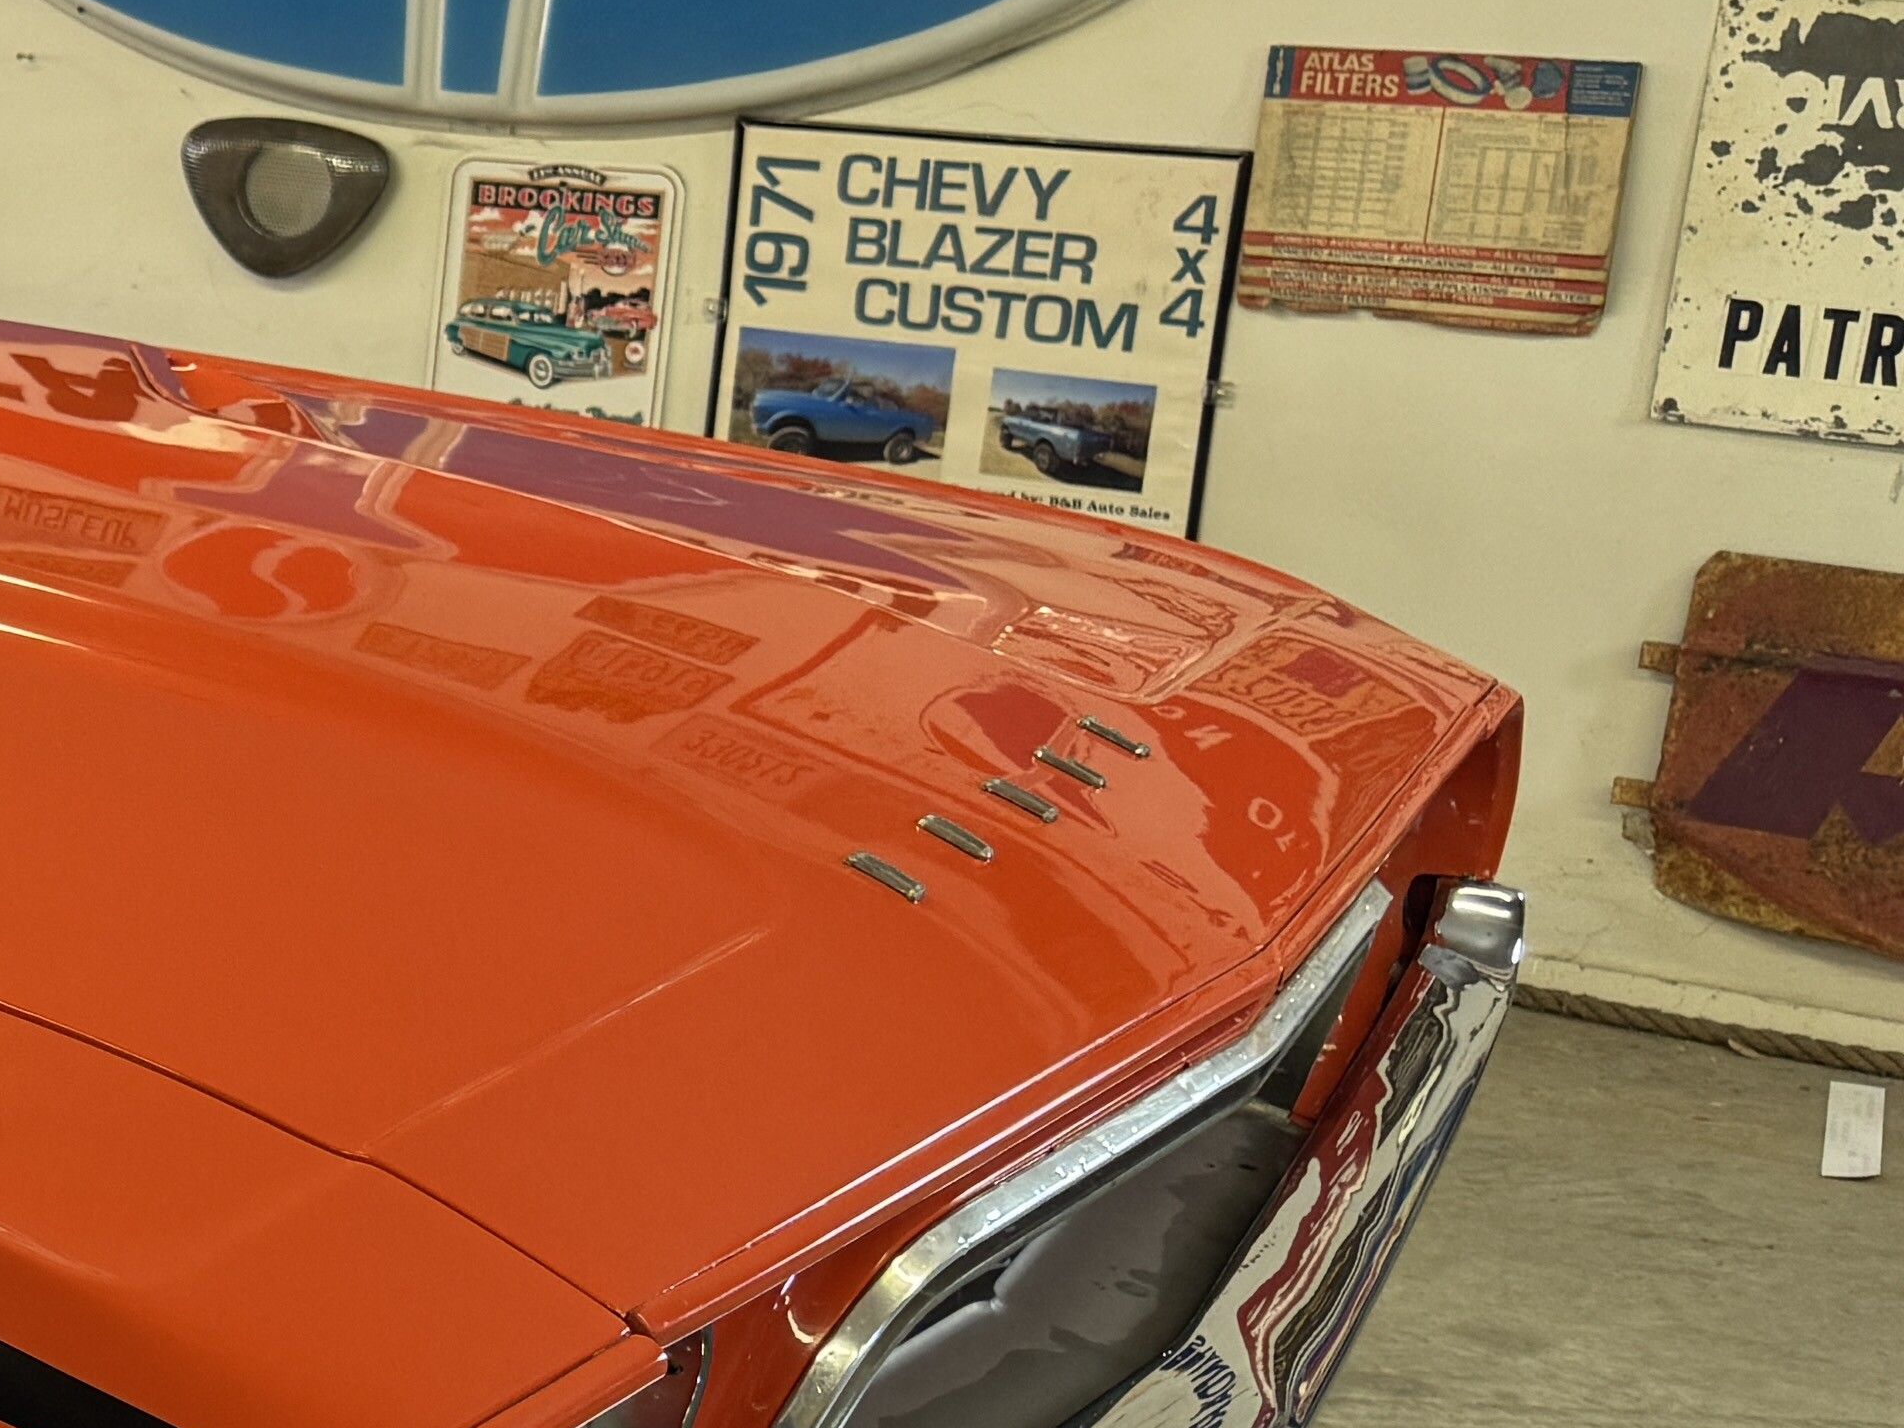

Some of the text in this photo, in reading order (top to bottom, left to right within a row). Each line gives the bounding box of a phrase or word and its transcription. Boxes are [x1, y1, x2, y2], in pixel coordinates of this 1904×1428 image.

[1299, 71, 1401, 98] FILTERS
[1303, 51, 1375, 72] ATLAS
[477, 184, 656, 217] BROOKINGS
[836, 152, 1070, 221] CHEVY
[536, 205, 590, 267] Car
[743, 152, 822, 308] 1971
[845, 217, 1098, 285] BLAZER
[854, 276, 1140, 354] CUSTOM
[1717, 297, 1904, 388] PATR
[1086, 499, 1125, 517] Auto
[1128, 504, 1171, 522] Sales
